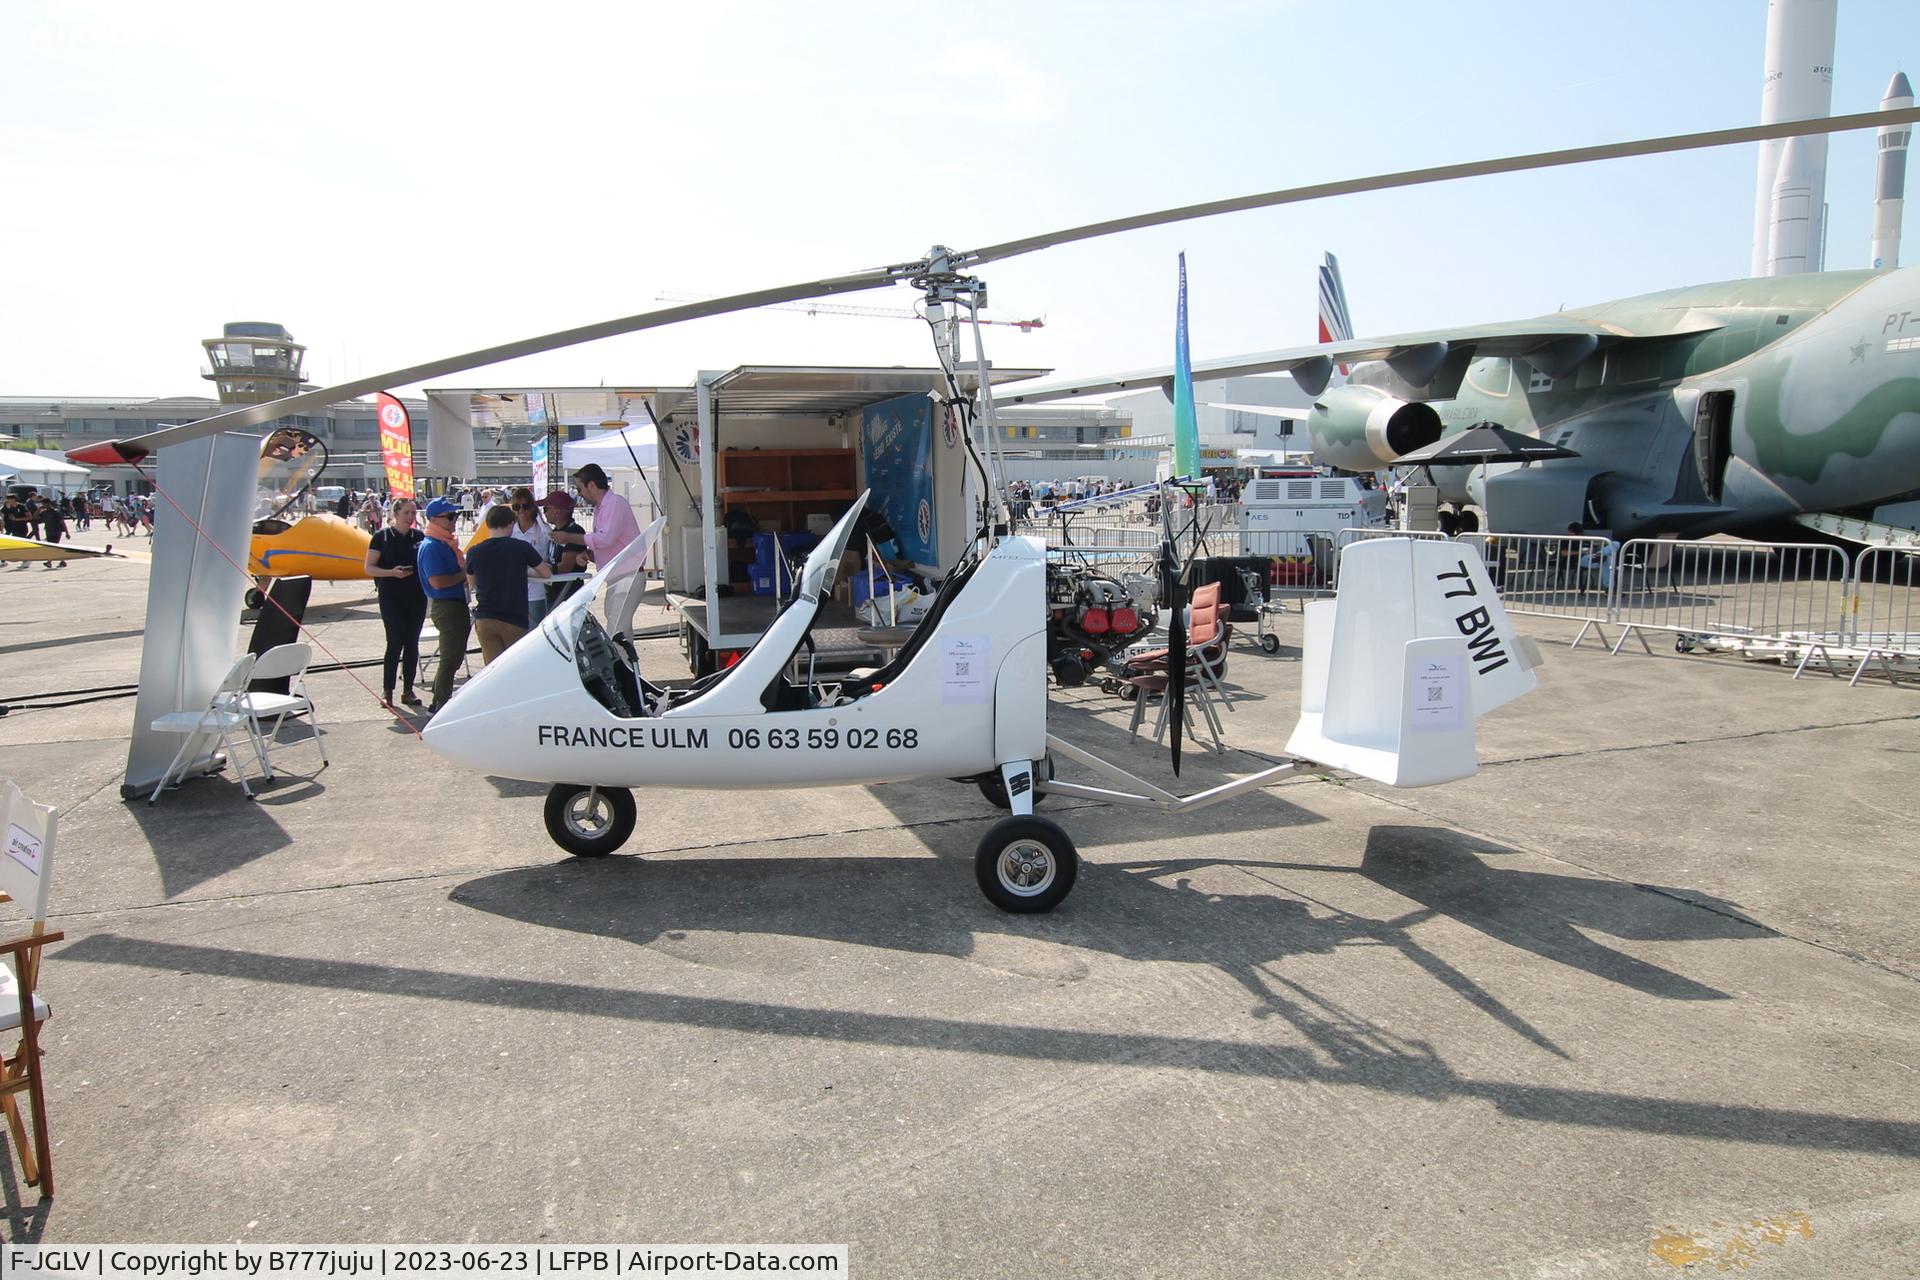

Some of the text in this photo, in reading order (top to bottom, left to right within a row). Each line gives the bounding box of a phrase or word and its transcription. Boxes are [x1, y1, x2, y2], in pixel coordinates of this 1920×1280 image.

[1437, 560, 1509, 675] 77 BWI
[538, 725, 919, 750] FRANCE ULM 06 63 59 02 68
